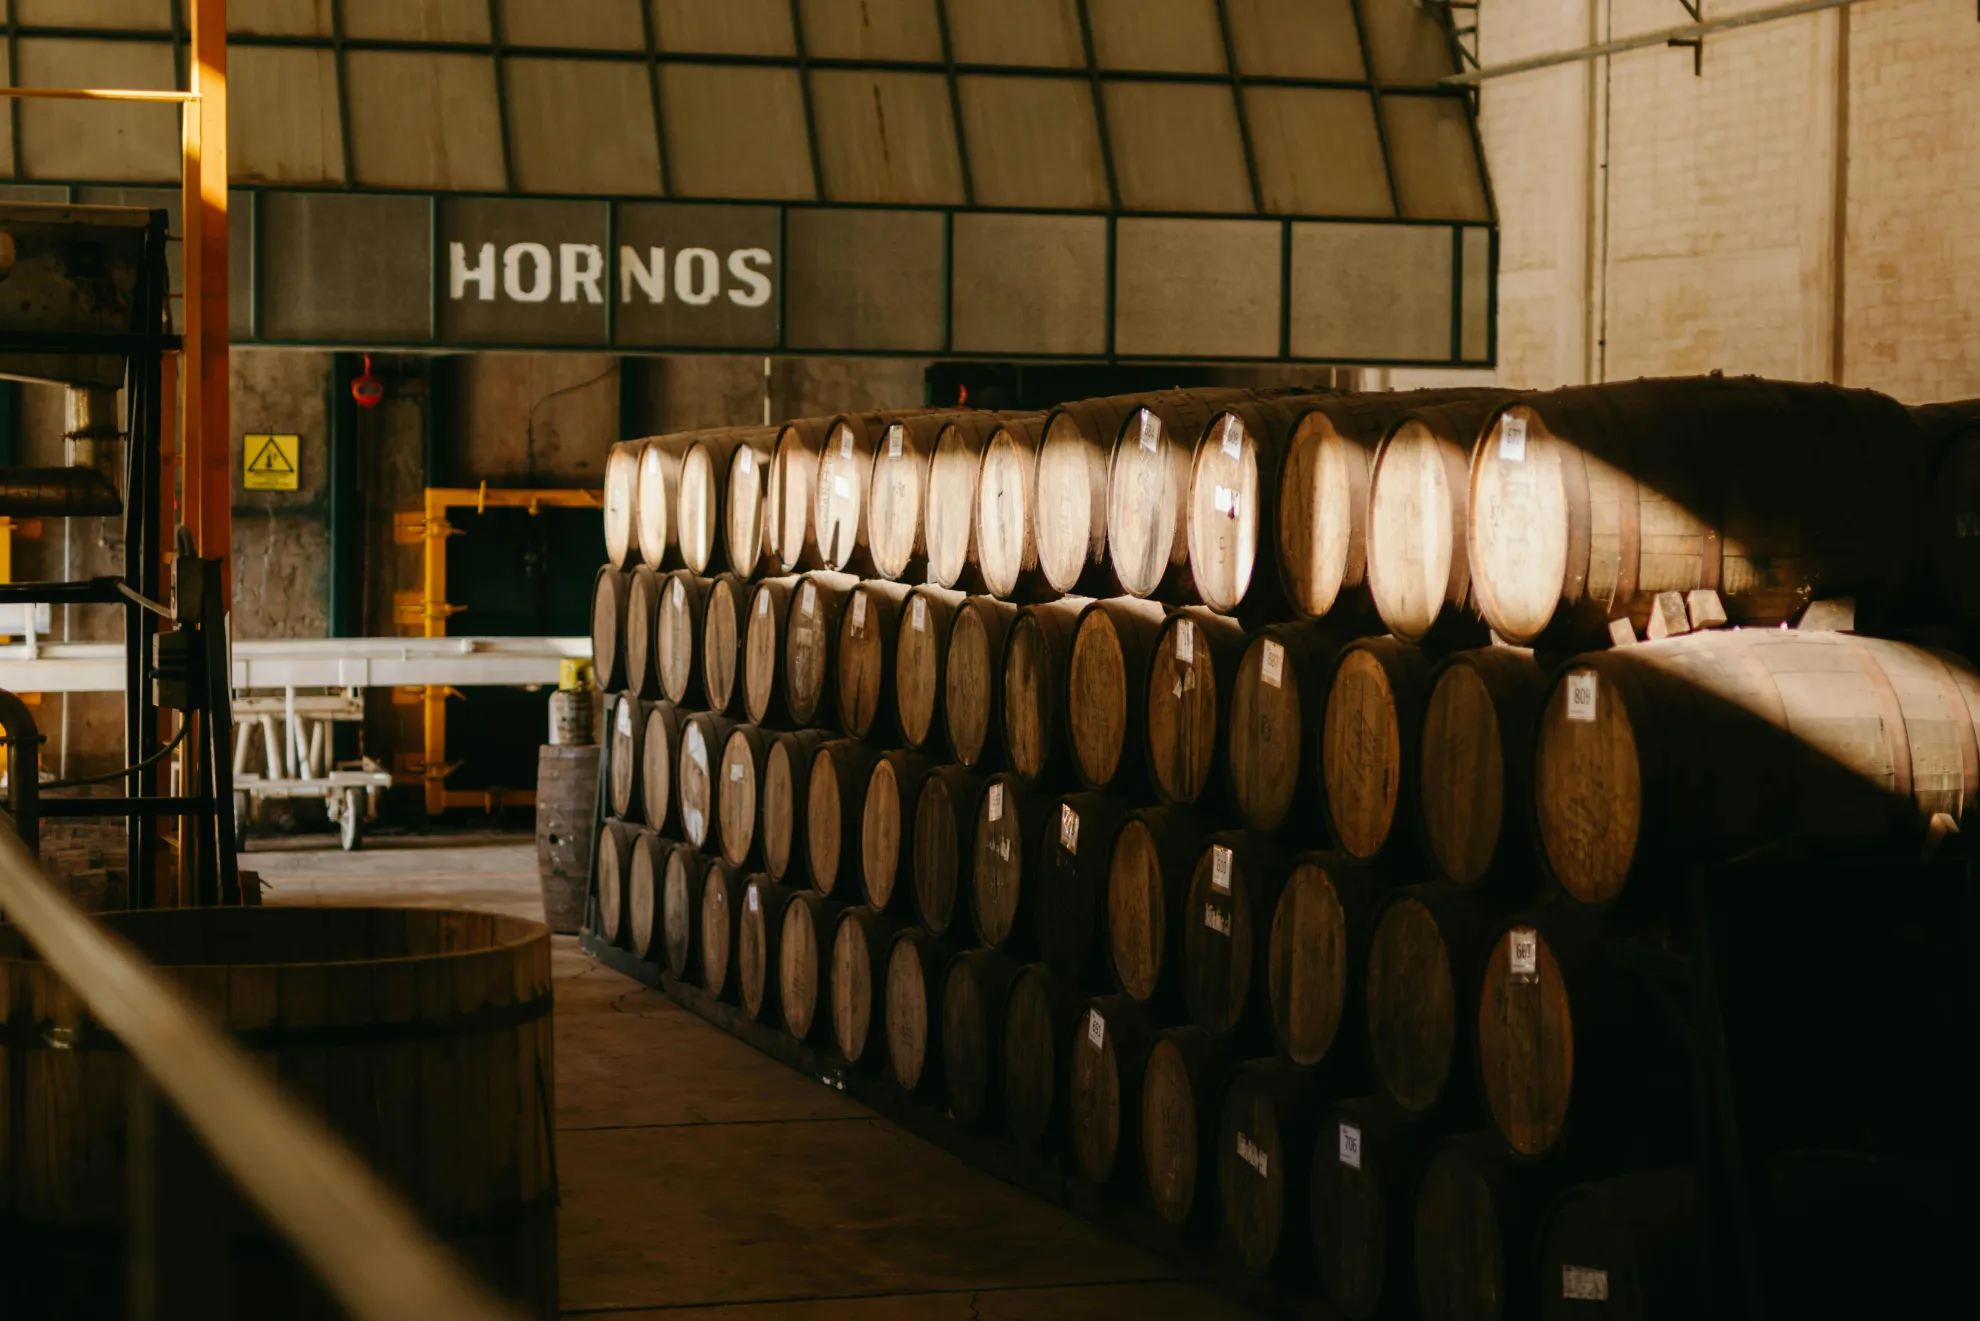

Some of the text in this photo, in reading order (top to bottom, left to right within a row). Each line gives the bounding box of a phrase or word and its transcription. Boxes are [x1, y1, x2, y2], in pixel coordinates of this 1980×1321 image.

[449, 240, 773, 309] HORNOS
[1574, 687, 1591, 705] 809
[1344, 1134, 1357, 1153] 706
